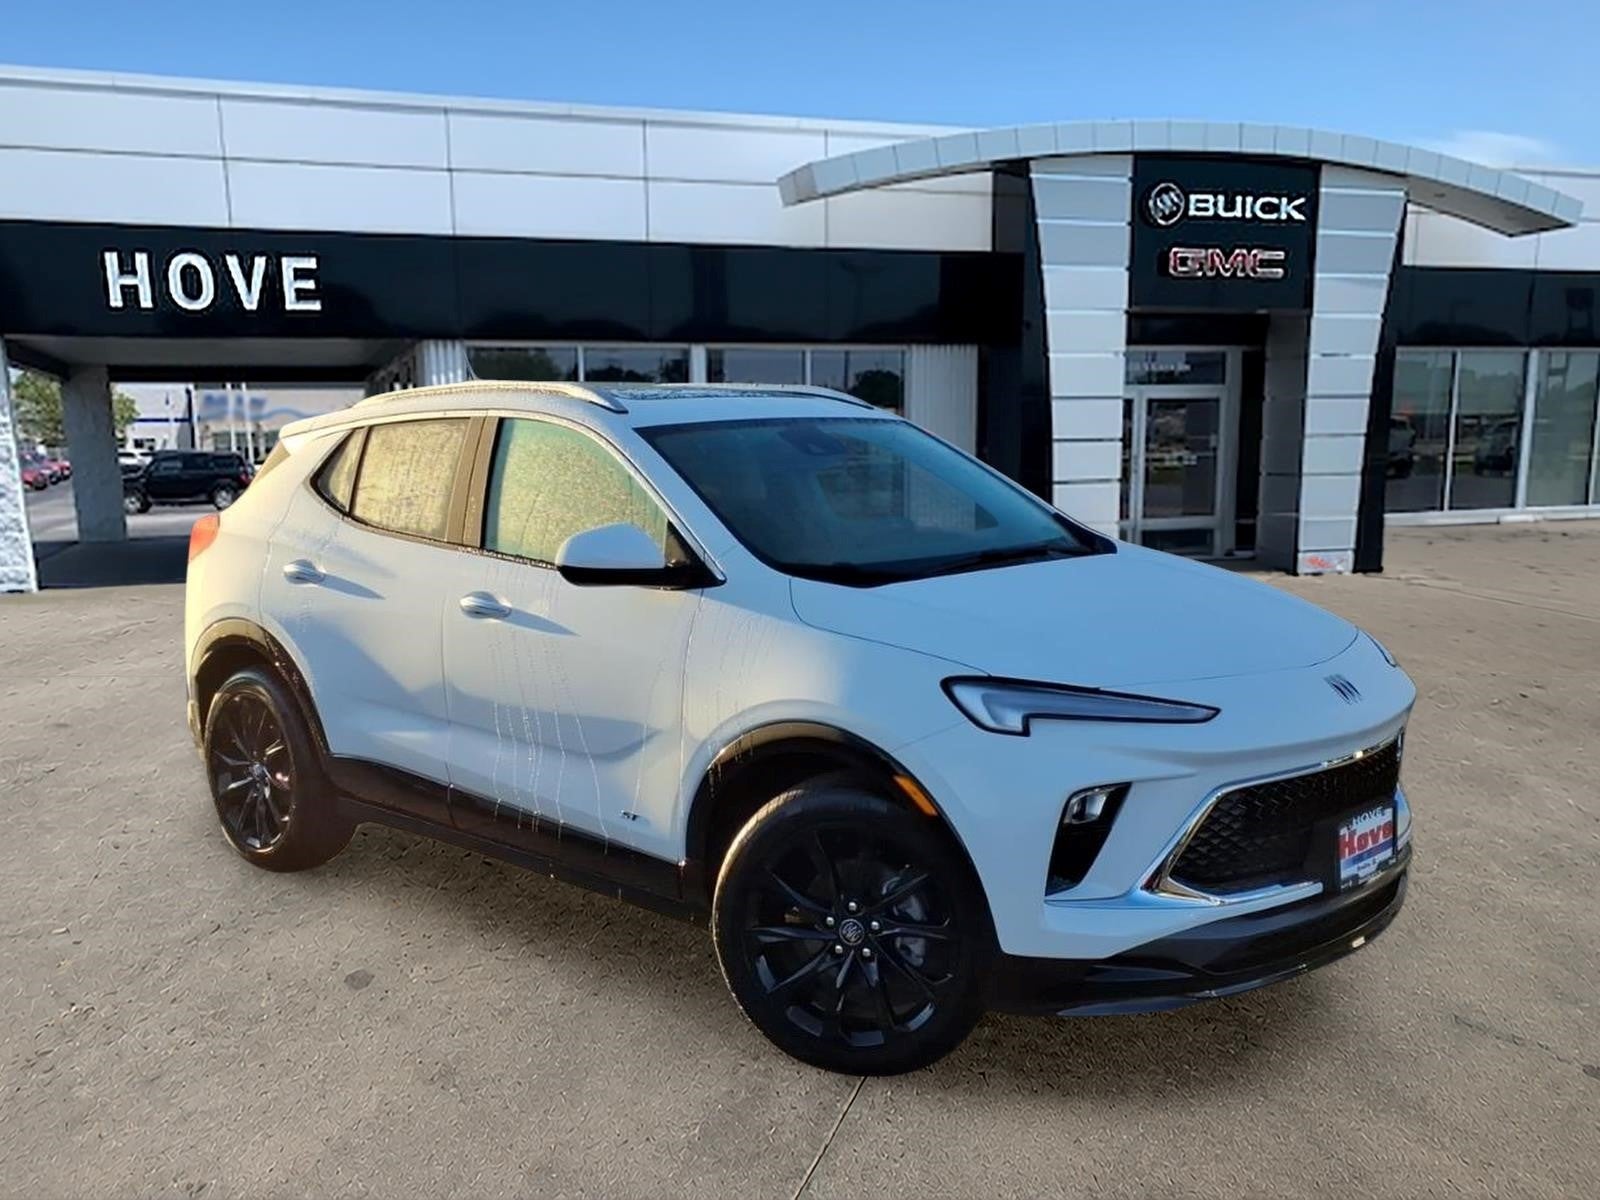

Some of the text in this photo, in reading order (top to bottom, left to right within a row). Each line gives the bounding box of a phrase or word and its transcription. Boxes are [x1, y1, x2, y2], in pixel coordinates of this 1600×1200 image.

[1188, 194, 1307, 220] BUICK
[1168, 247, 1285, 277] GMC
[104, 252, 322, 311] HOVE
[1339, 820, 1393, 860] Hove
